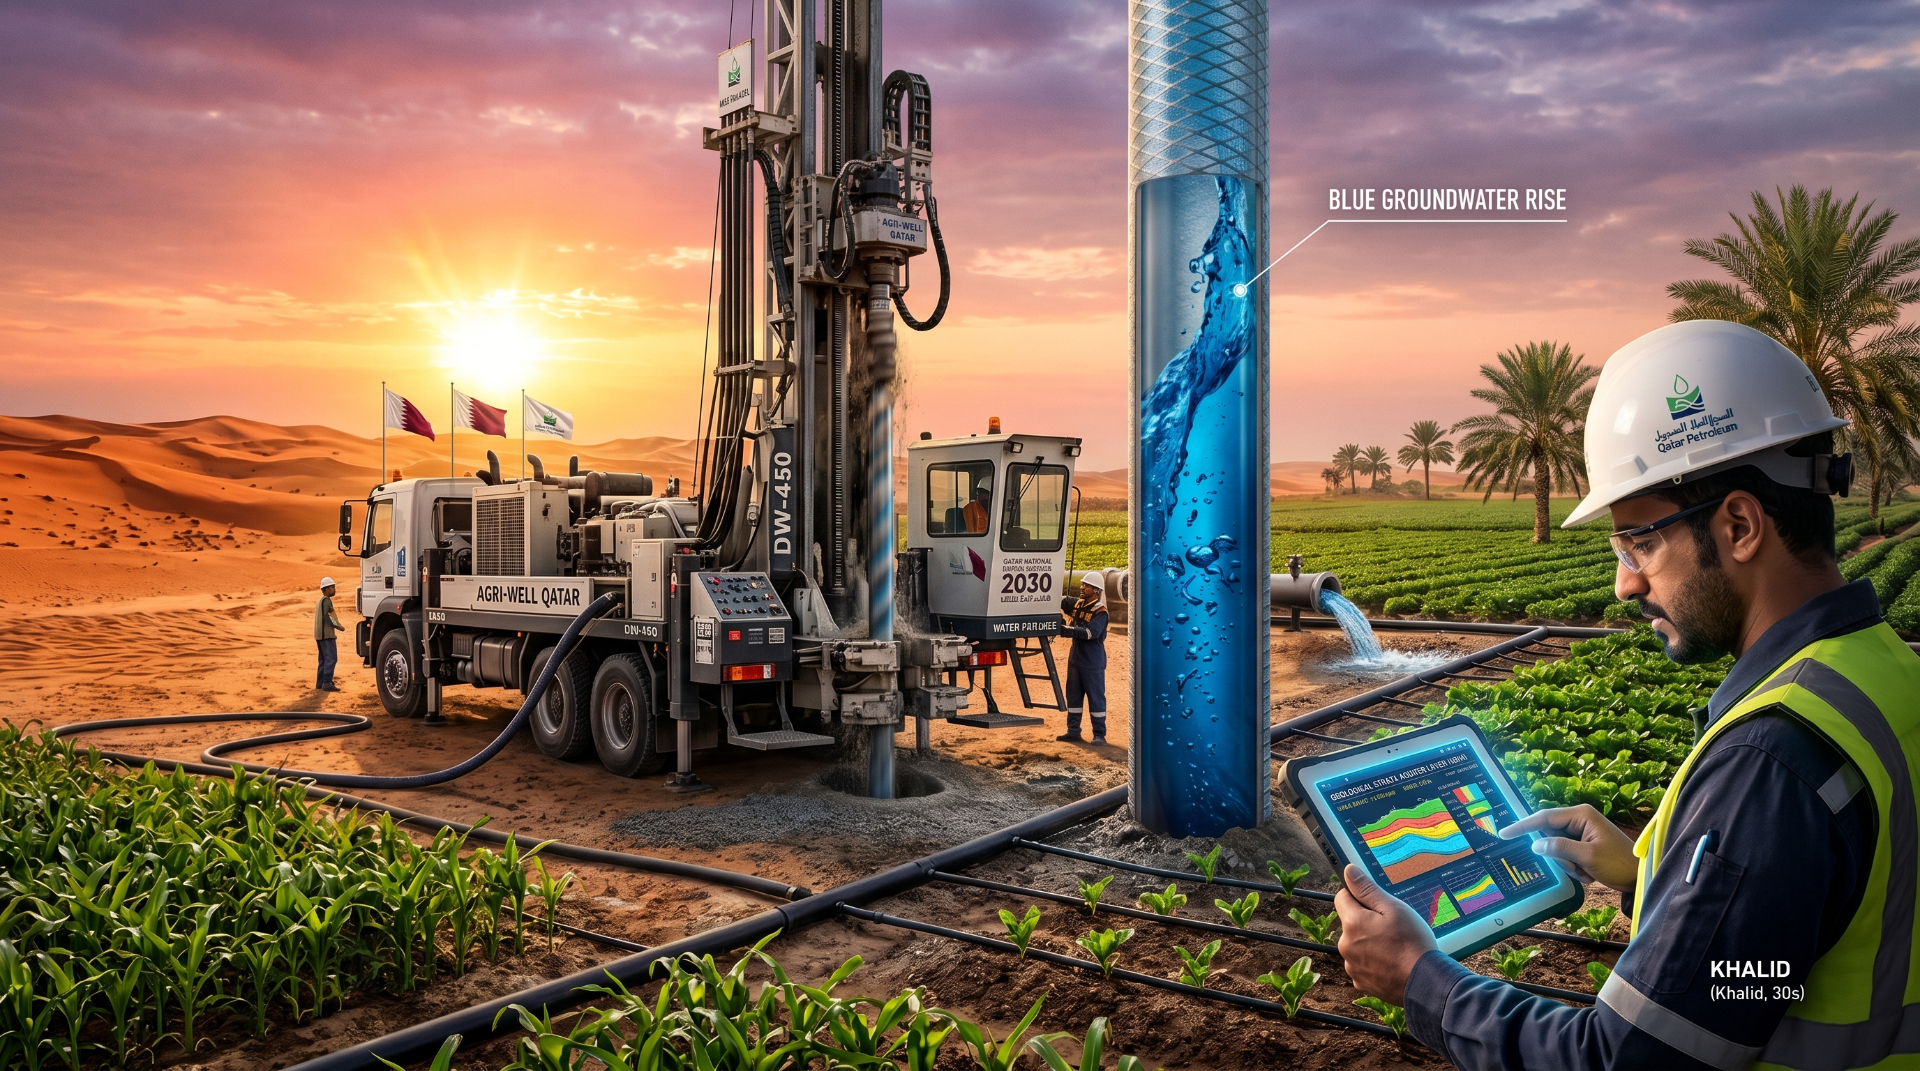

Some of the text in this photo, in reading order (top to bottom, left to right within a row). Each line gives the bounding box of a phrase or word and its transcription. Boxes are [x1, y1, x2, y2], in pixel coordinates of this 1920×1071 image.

[1657, 438, 1686, 454] Qatar
[773, 451, 792, 555] DW-450
[1001, 573, 1052, 593] 2030
[476, 585, 581, 608] AGRI-WELL QATAR
[993, 622, 1020, 633] WATER
